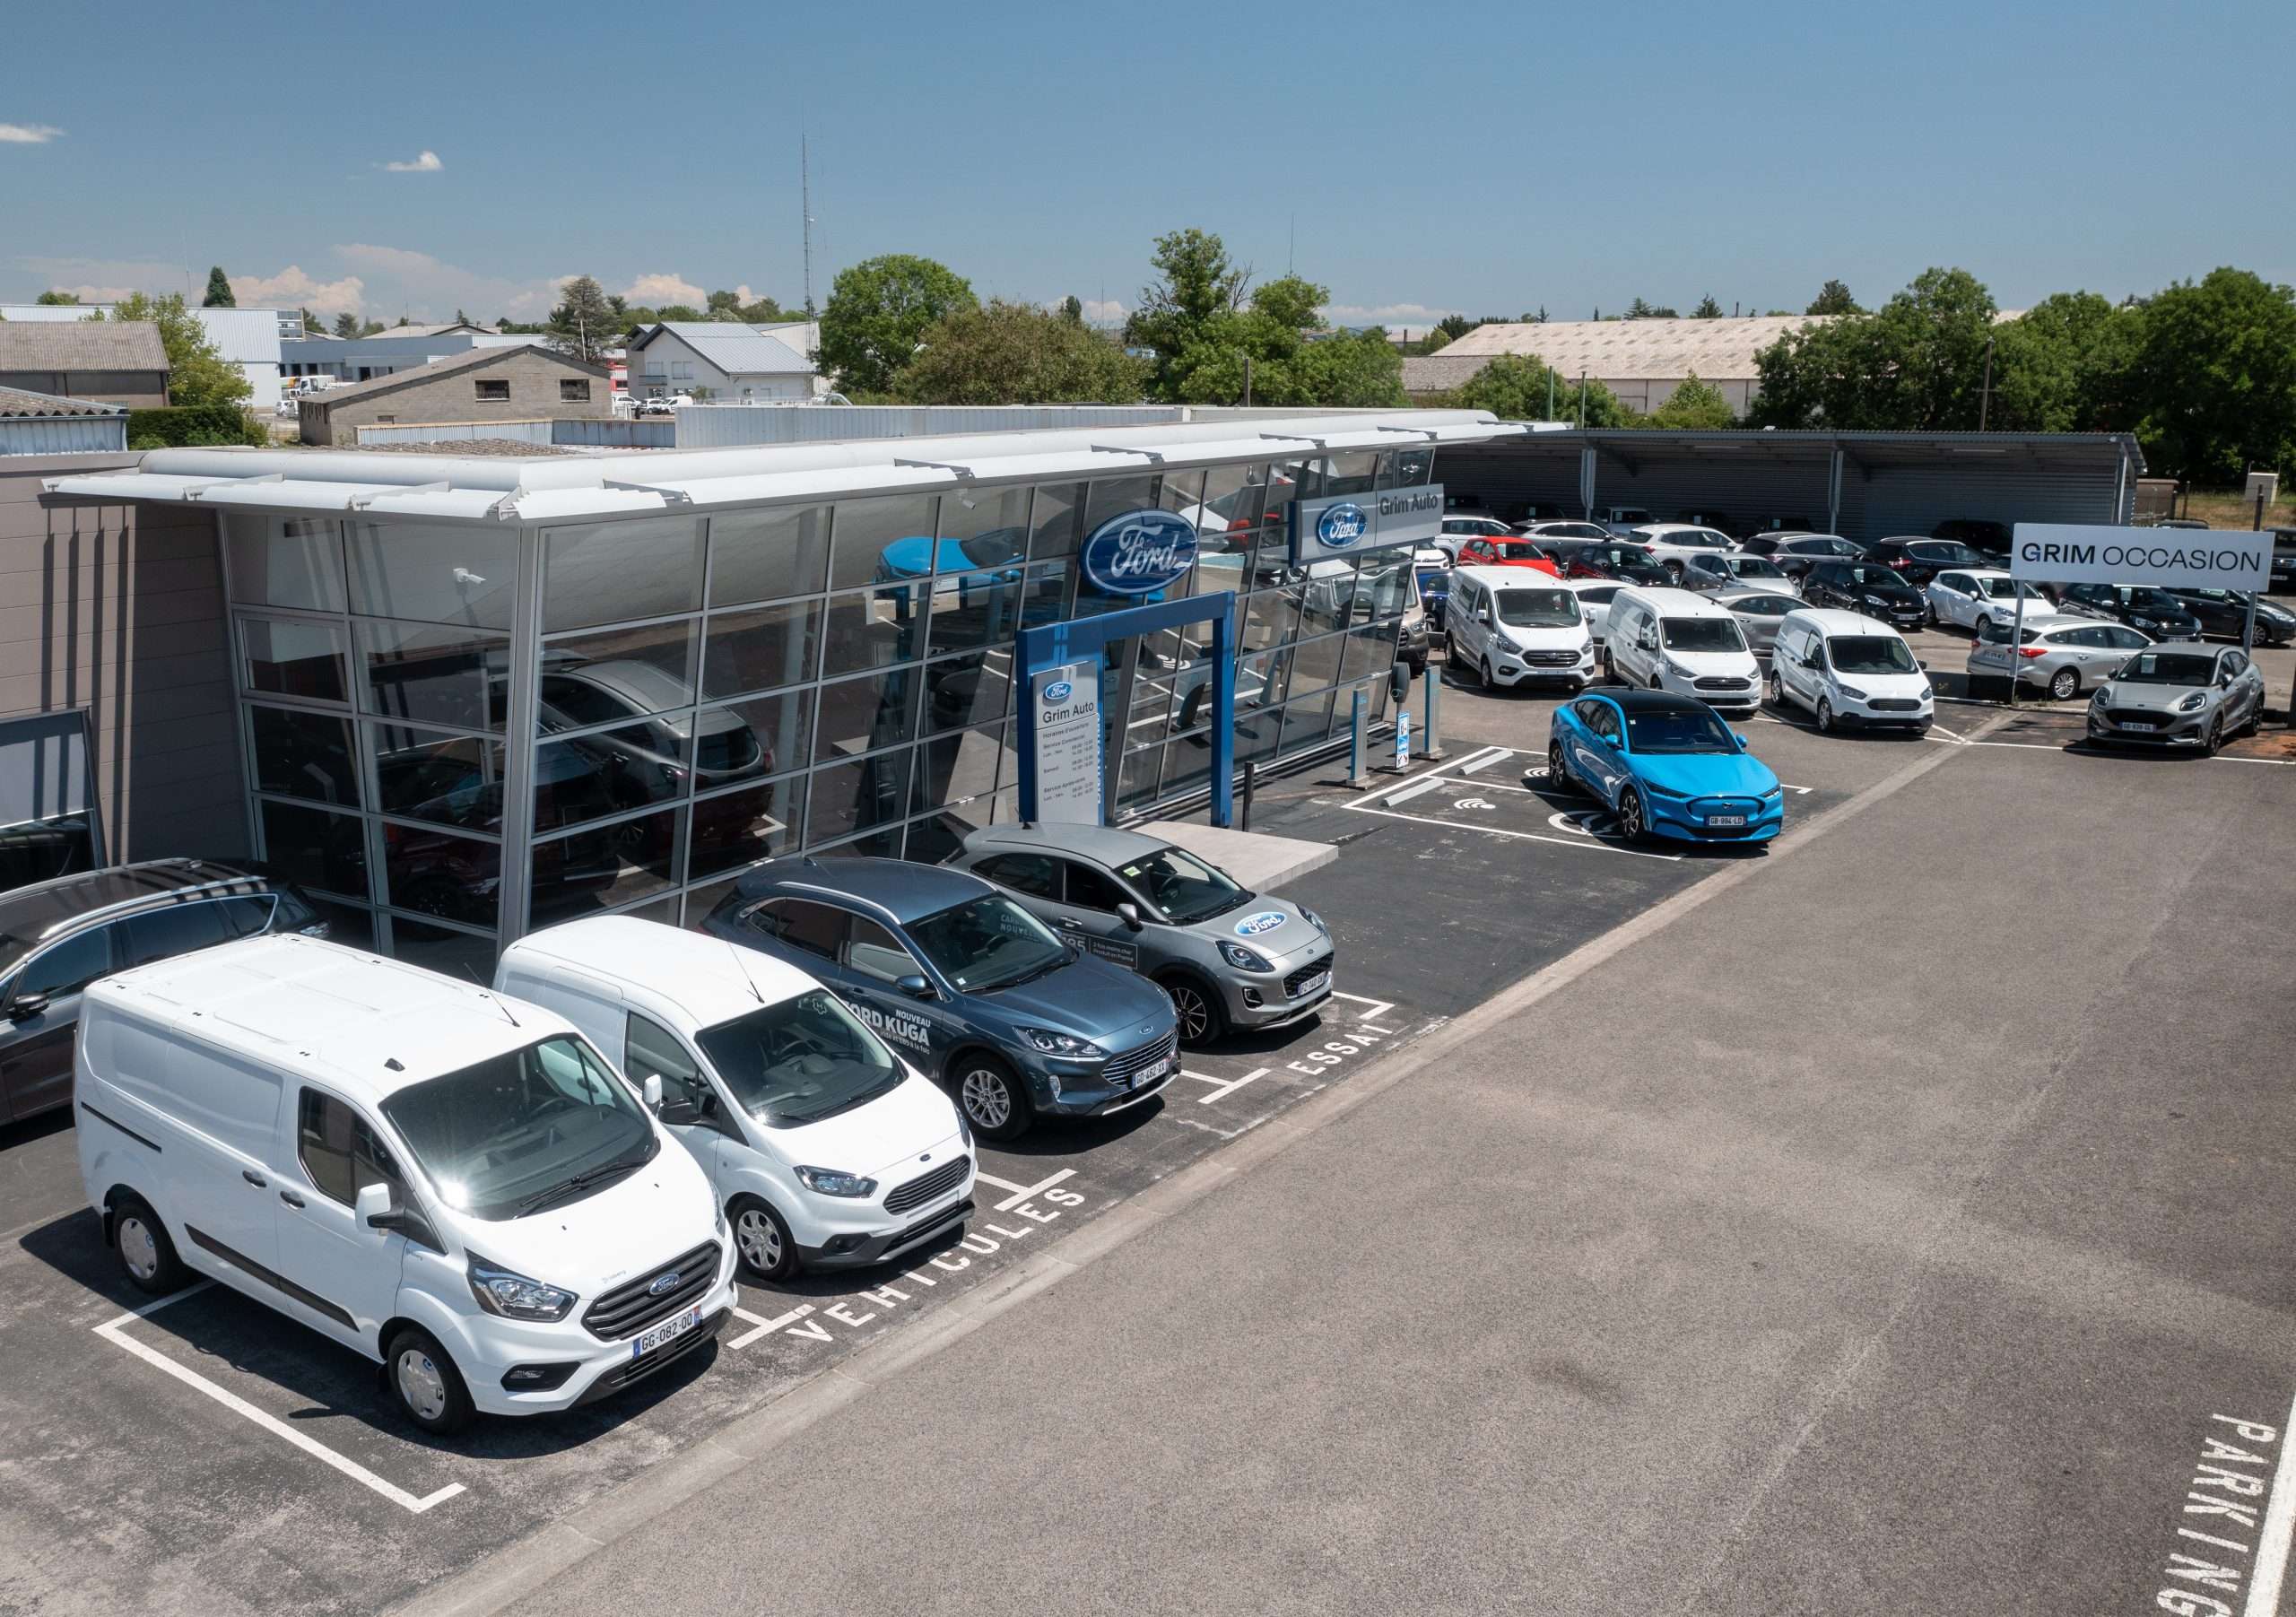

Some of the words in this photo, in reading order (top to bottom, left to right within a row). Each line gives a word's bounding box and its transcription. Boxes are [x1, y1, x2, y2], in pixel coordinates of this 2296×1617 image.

[1379, 497, 1409, 516] Grim
[1411, 492, 1439, 512] Auto
[1330, 511, 1360, 539] Ford
[1110, 524, 1179, 578] Ford
[2022, 543, 2095, 564] GRIM
[2102, 546, 2261, 572] OCCASION
[1042, 709, 1070, 724] Grim
[1072, 701, 1094, 716] Auto
[1243, 915, 1282, 933] Ford
[884, 1015, 930, 1047] KUGA
[895, 1009, 931, 1028] NOUVEAU
[1288, 1024, 1392, 1075] ESSAI
[786, 1188, 1084, 1343] VEHICULES
[2156, 1413, 2277, 1617] PARKING
